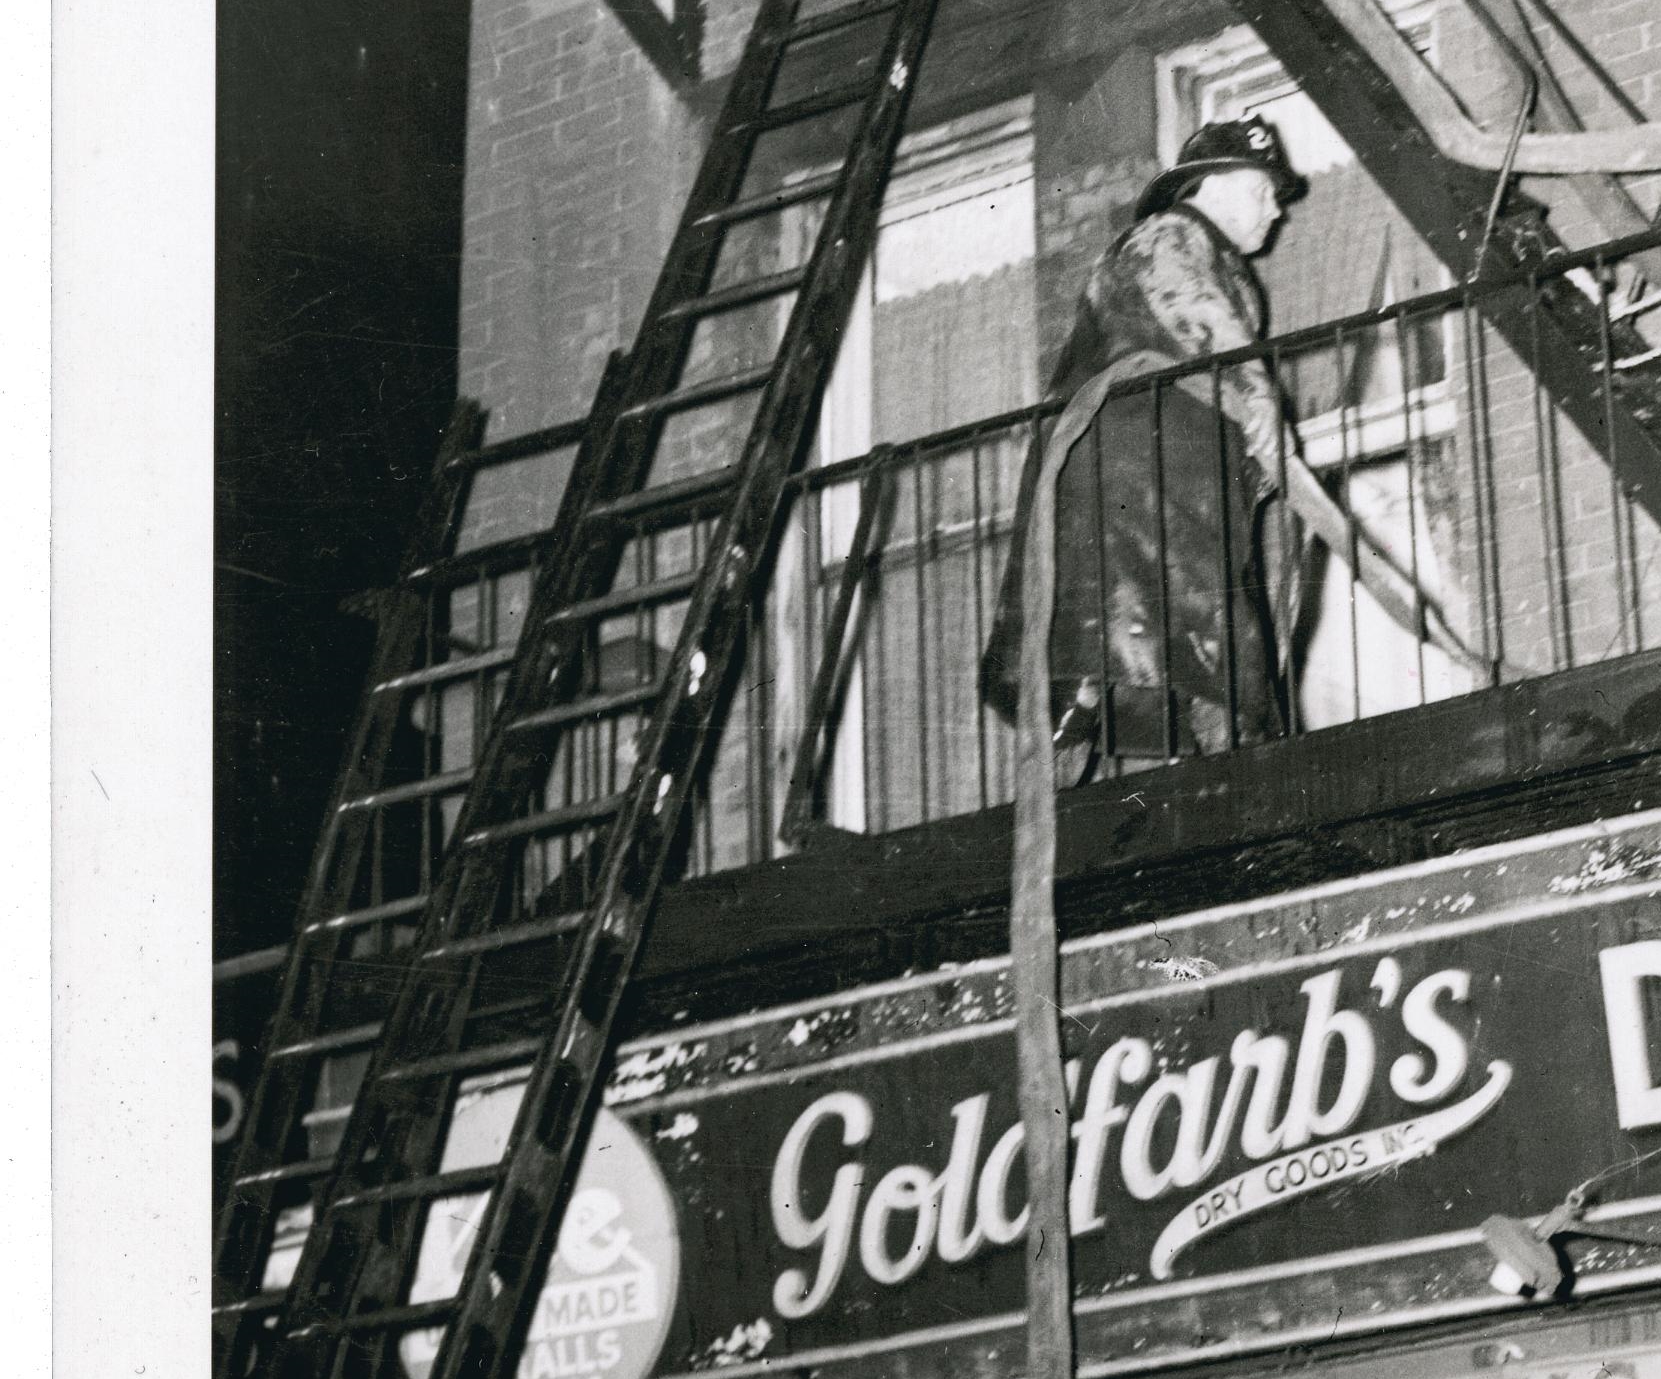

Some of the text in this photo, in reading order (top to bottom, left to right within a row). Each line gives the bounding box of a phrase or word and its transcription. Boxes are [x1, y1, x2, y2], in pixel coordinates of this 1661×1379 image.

[1194, 1179, 1245, 1230] DRY
[1264, 1139, 1368, 1194] GOODS
[544, 1280, 638, 1329] MADE
